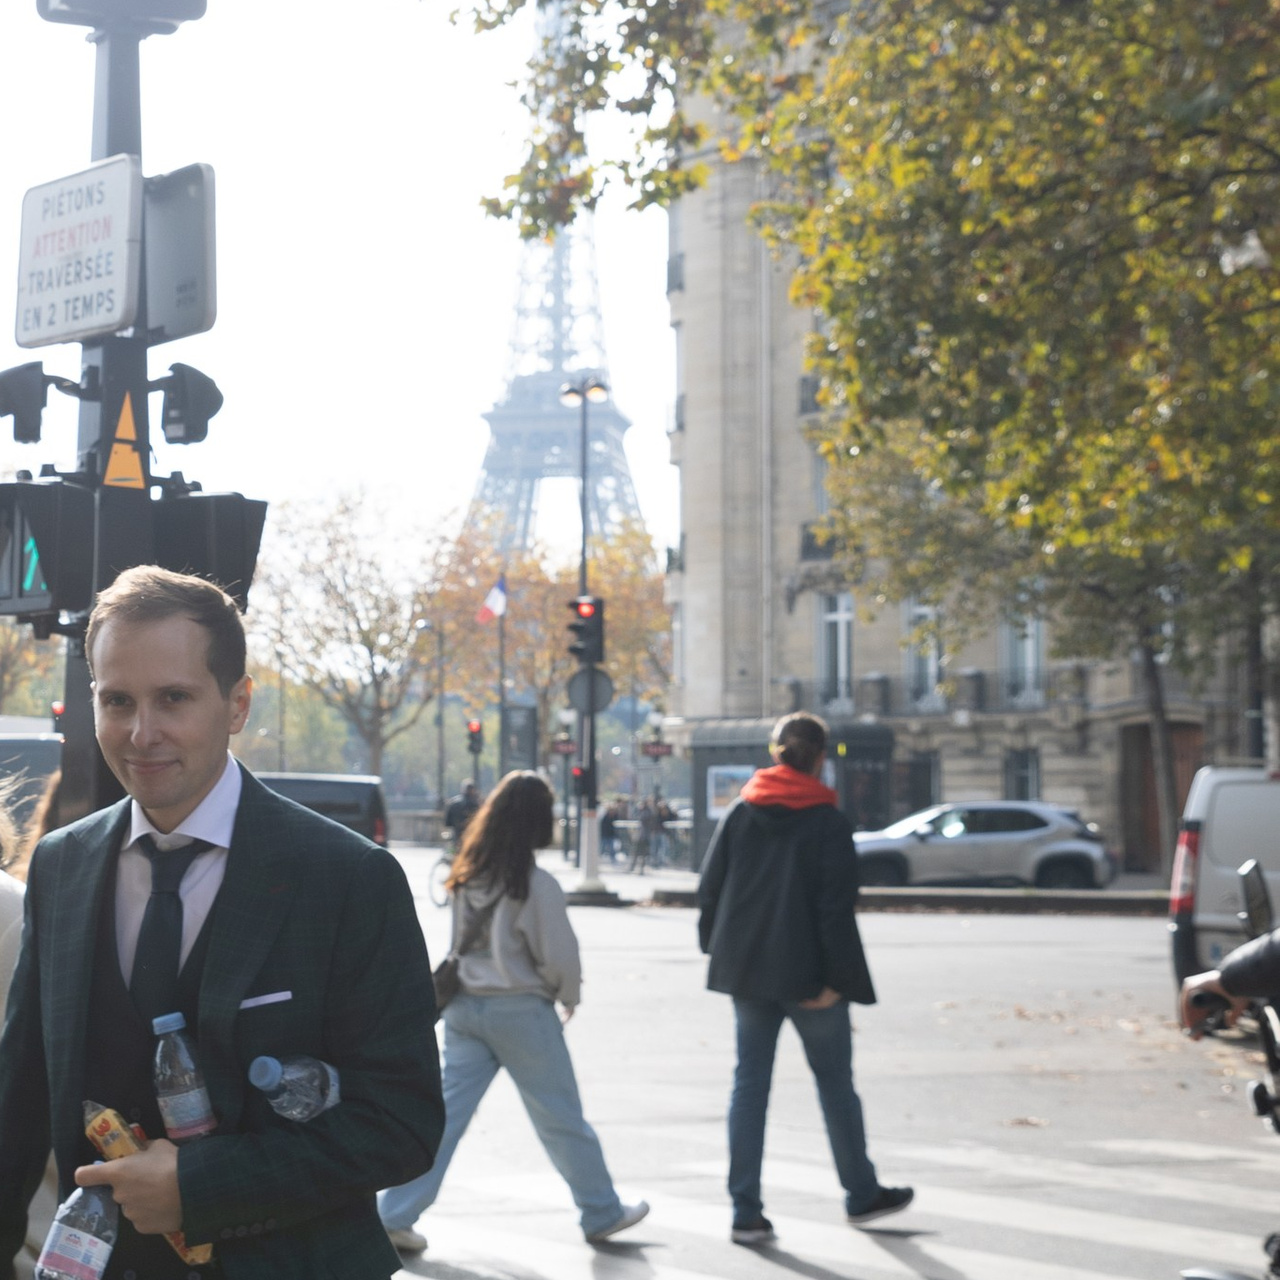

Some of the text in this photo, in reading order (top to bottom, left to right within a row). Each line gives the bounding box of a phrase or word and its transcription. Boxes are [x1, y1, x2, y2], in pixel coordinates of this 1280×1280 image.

[42, 180, 105, 222] PIÉTONS
[32, 214, 113, 260] ATTENTION
[28, 248, 115, 296] TRAVERSÉE
[22, 288, 116, 332] EN 2 TEMPS
